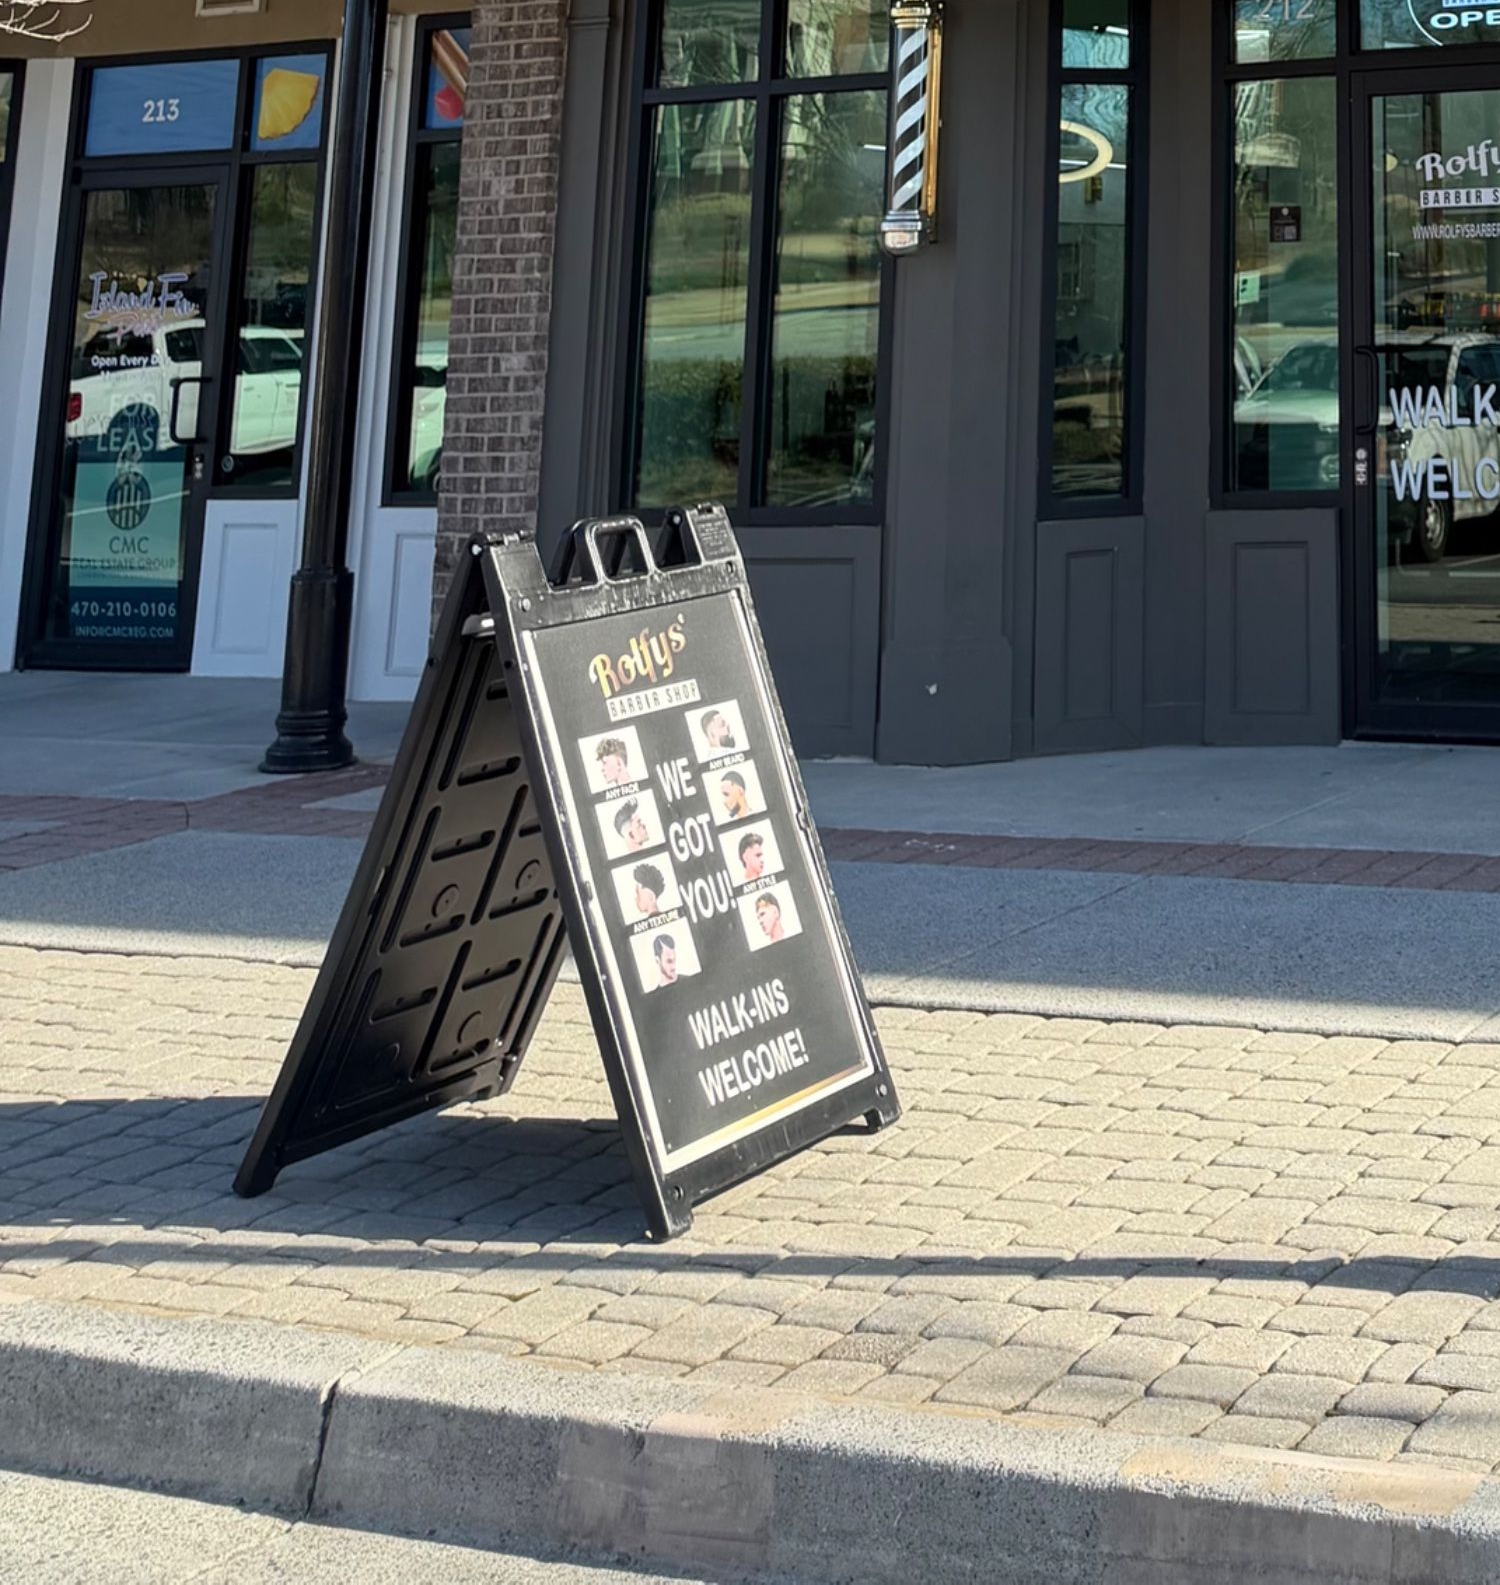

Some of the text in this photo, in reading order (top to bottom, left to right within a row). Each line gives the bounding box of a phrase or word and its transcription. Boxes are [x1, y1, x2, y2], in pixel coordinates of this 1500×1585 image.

[142, 98, 180, 123] 213
[1422, 191, 1483, 206] BARBER
[84, 270, 156, 318] Island
[91, 355, 117, 370] Open
[119, 355, 149, 369] Every
[109, 536, 149, 554] CMC
[100, 558, 136, 571] ESTATE
[137, 557, 177, 572] GROUP
[71, 601, 177, 617] 470-210-0106
[610, 681, 698, 718] BARBER SHOP
[709, 753, 746, 770] ANY BEARD
[606, 782, 640, 800] ANY FADE
[656, 757, 697, 803] WE
[668, 813, 715, 862] GOT
[679, 869, 737, 923] YOU!
[743, 875, 777, 895] ANY STYLE
[633, 909, 680, 933] ANY TEXTURE
[688, 978, 790, 1050] WALK-INS
[698, 1027, 810, 1107] WELCOME!
